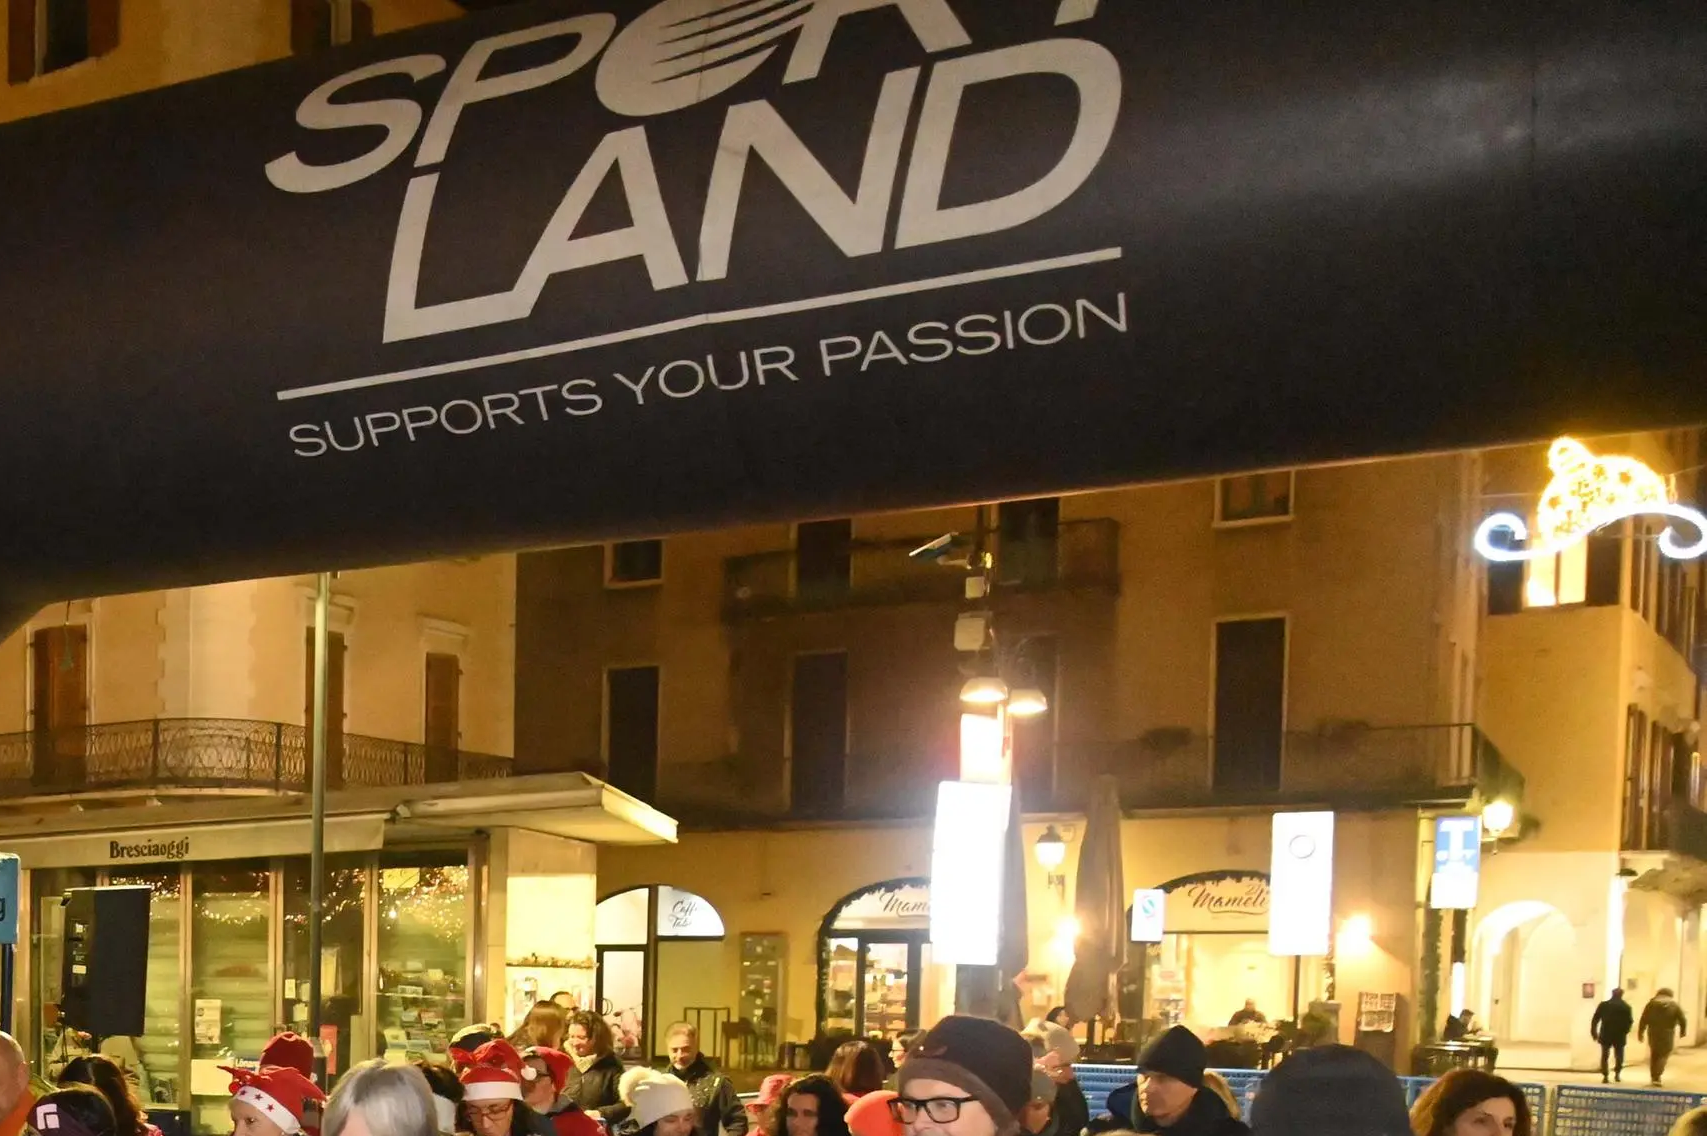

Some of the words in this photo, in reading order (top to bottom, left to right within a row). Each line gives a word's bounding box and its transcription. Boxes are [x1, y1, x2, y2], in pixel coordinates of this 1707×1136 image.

[264, 0, 1095, 193] SPO
[382, 37, 1123, 344] LAND
[288, 378, 604, 458] SUPPORTS
[612, 344, 800, 406] YOUR
[818, 291, 1128, 377] PASSION
[108, 836, 191, 860] Bresciaoggi
[879, 891, 931, 918] Mam
